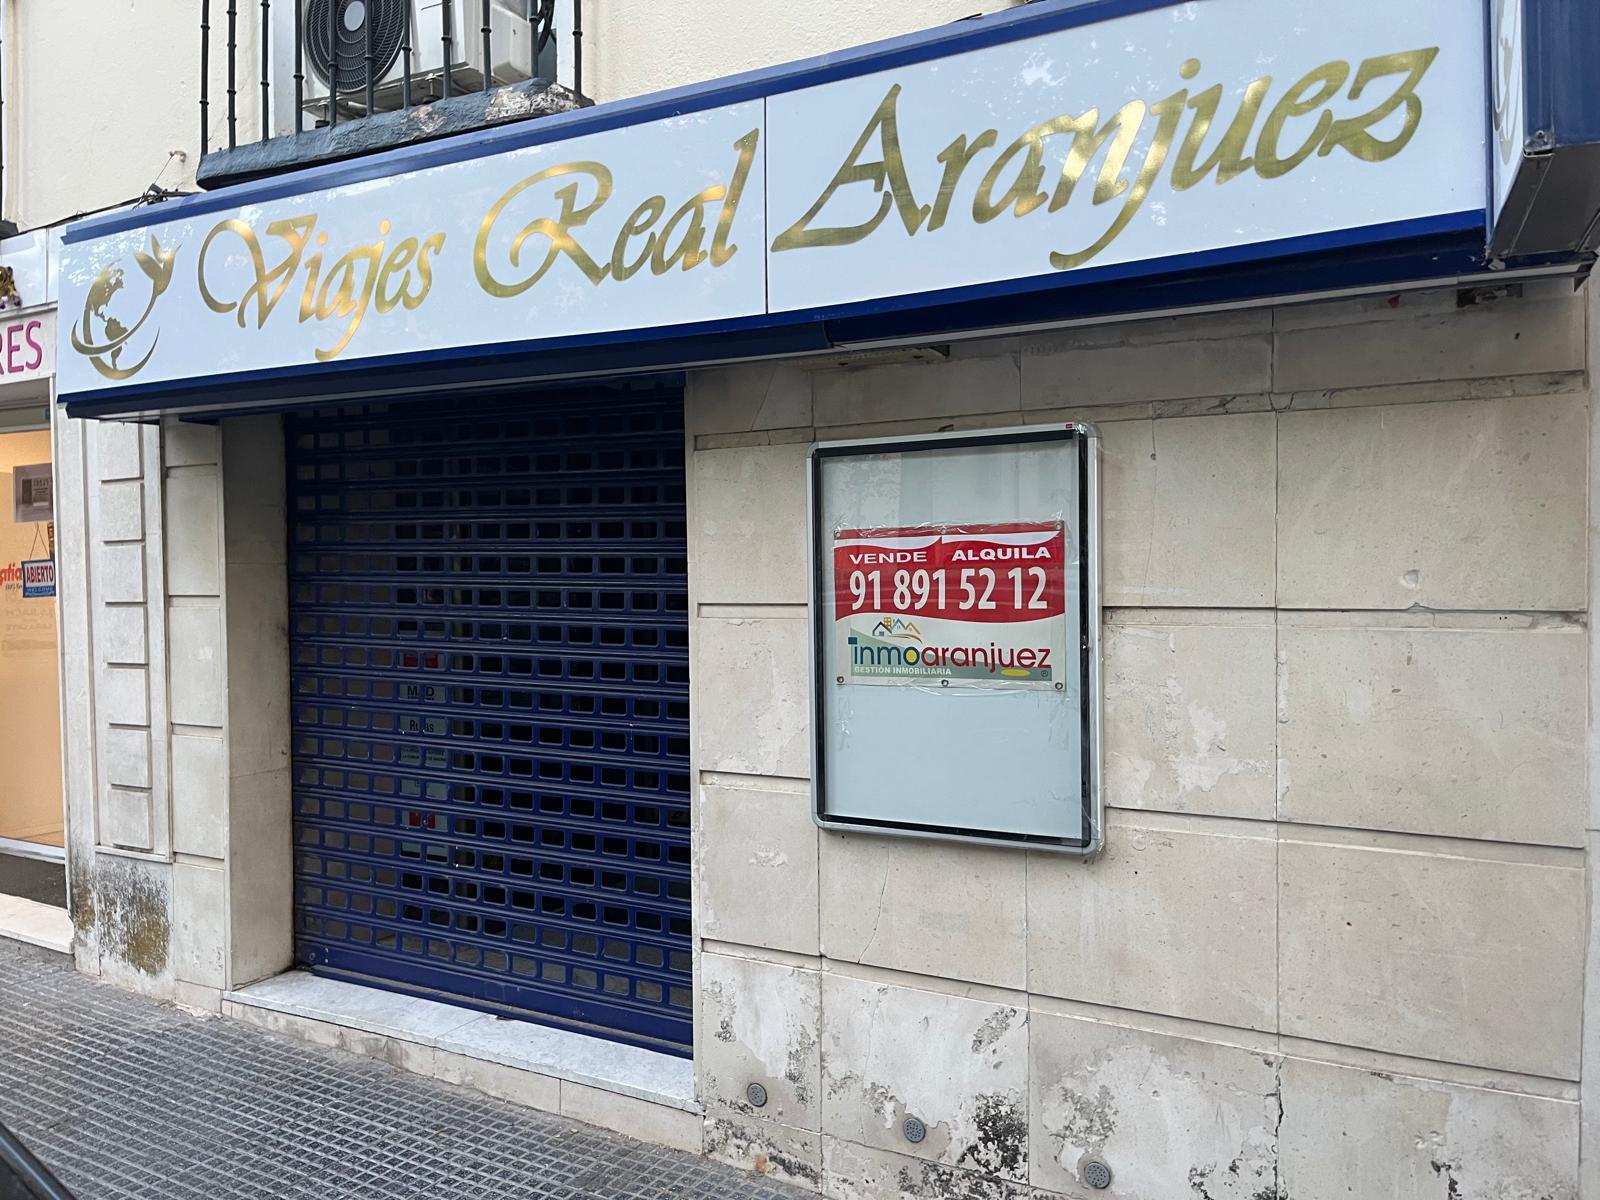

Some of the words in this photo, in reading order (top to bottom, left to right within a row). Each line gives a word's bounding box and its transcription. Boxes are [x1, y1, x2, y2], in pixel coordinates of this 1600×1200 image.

[198, 213, 446, 362] Viajes
[473, 127, 760, 298] Real
[770, 46, 1440, 271] Aranjuez
[849, 551, 928, 565] VENDE
[951, 547, 1051, 561] ALQUILA
[26, 565, 54, 584] ABIERTO
[849, 570, 881, 610] 91
[893, 568, 946, 610] 891
[958, 567, 996, 610] 52
[1007, 566, 1048, 610] 12
[848, 637, 1052, 673] inmoaranjuez
[892, 667, 952, 676] INMOBILIARIA
